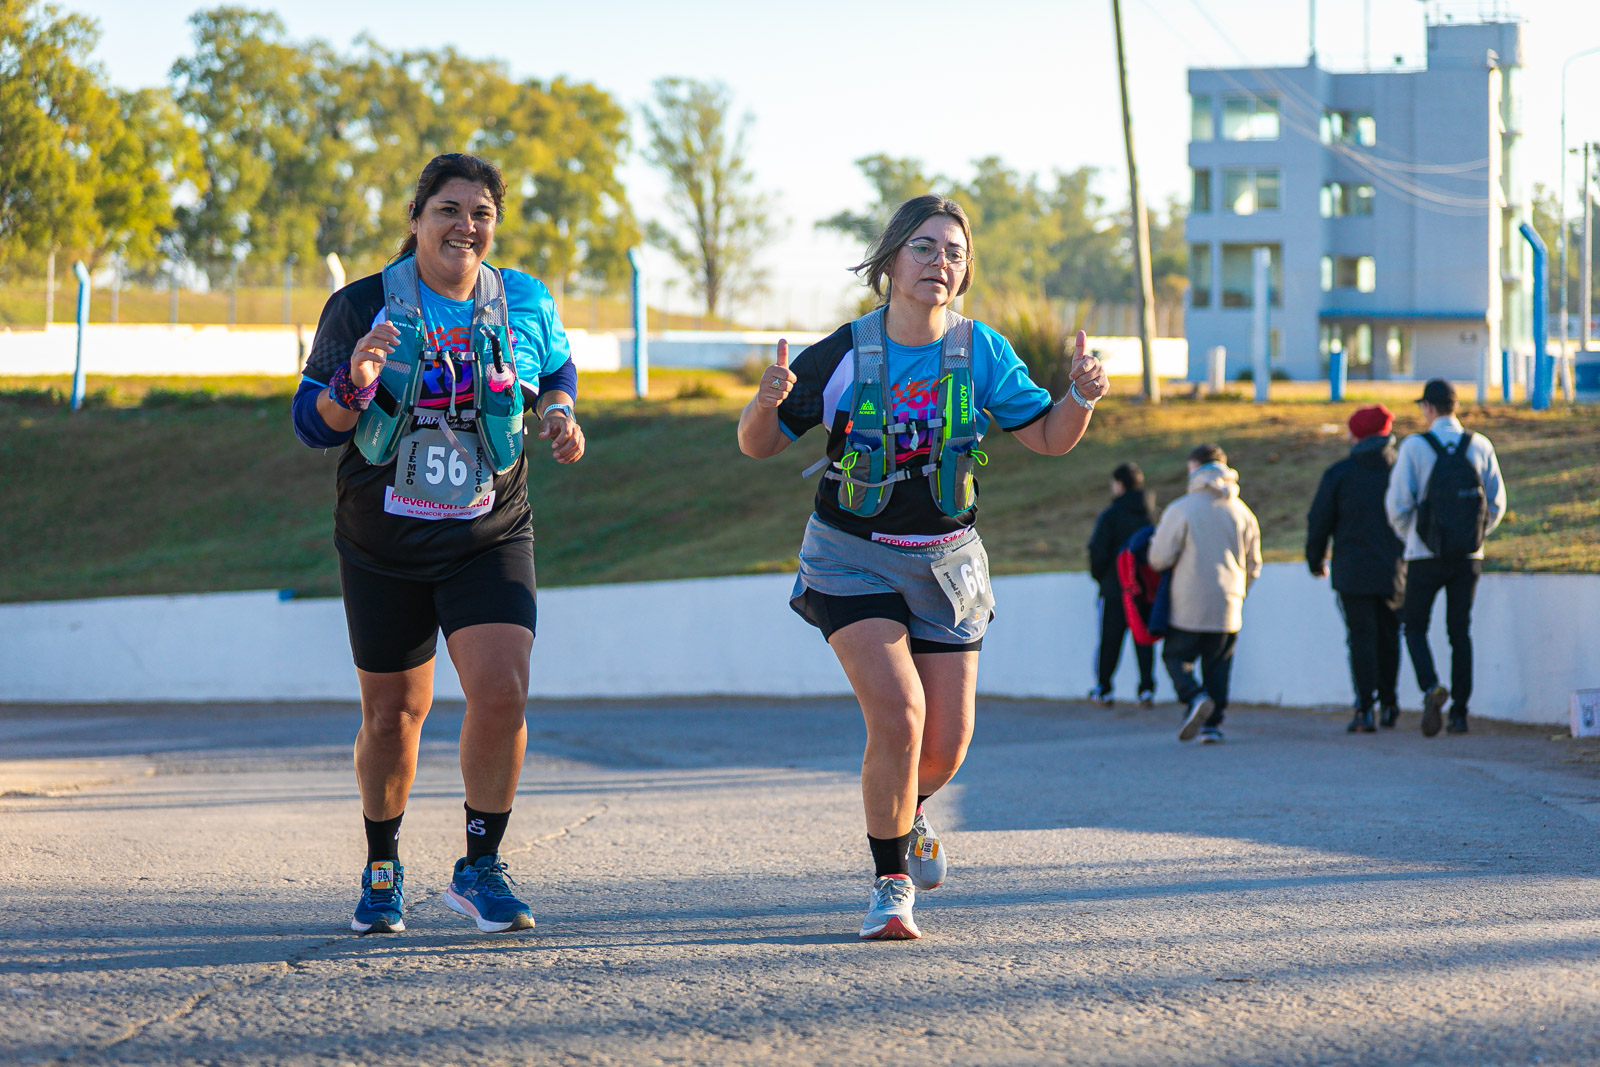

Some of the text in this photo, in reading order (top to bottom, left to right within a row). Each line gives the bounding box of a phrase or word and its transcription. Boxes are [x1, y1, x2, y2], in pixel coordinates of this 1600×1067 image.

[960, 383, 969, 425] AONIJE
[405, 441, 419, 485] TIEMPO
[425, 445, 468, 487] 56
[415, 509, 442, 517] SANCOR
[960, 558, 986, 599] 66
